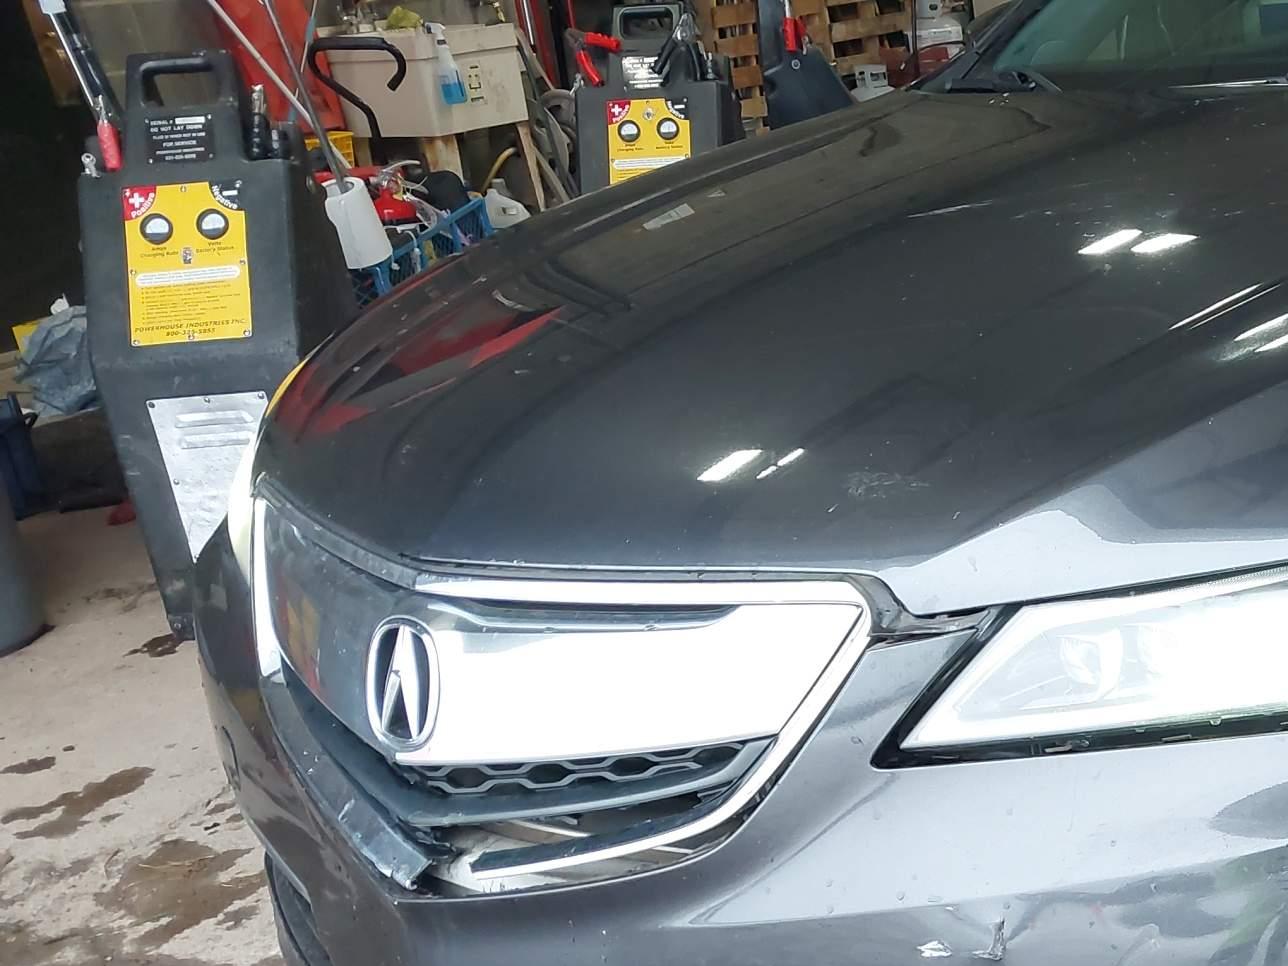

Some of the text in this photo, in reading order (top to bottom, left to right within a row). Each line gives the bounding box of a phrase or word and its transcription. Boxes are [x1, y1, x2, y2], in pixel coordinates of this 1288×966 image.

[130, 192, 155, 219] Positive
[211, 185, 238, 210] Negative
[135, 323, 183, 333] POWERHOUSE
[185, 319, 230, 329] INDUSTRIES
